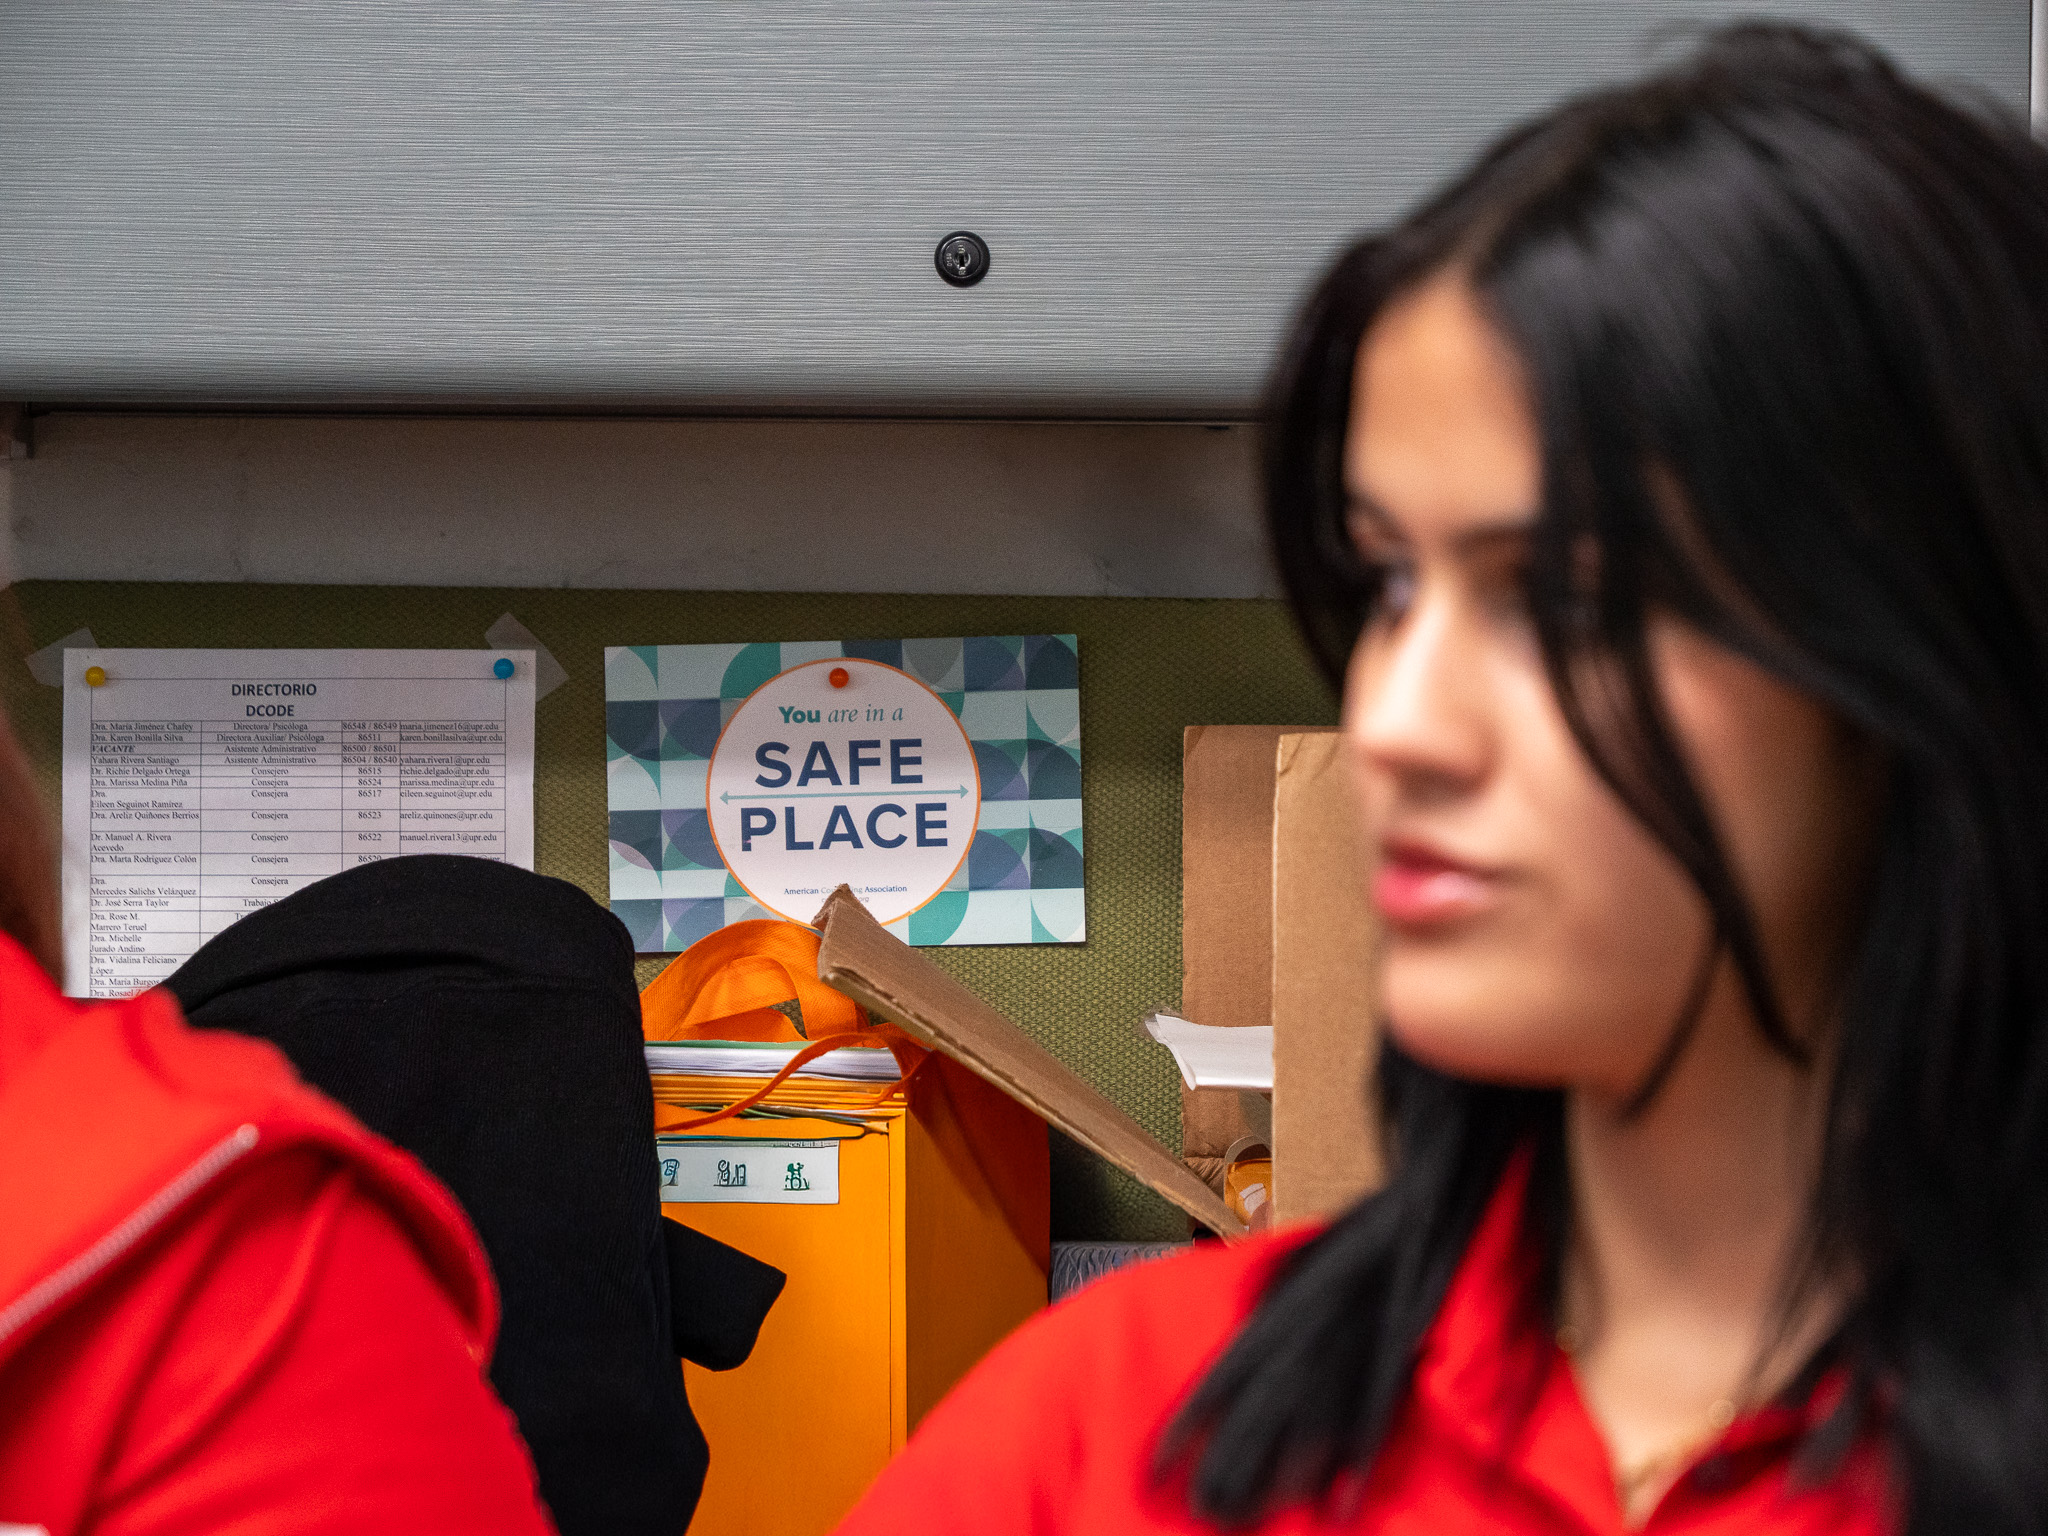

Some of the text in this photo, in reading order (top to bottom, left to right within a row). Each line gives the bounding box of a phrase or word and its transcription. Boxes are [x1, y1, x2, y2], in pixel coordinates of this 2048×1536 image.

[232, 684, 316, 696] DIRECTORIO
[246, 705, 294, 717] DCODE
[778, 704, 904, 724] You are in a
[92, 722, 107, 730] Dra.
[342, 722, 366, 730] 86548
[374, 722, 398, 730] 86549
[92, 732, 184, 742] Dra. Karen Bonilla Silva
[92, 756, 180, 766] Yahara Rivera Santiago
[342, 756, 366, 764] 86504
[374, 756, 398, 764] 86540
[755, 738, 923, 788] SAFE
[132, 768, 163, 776] Delgado
[164, 768, 190, 777] Ortega
[252, 768, 288, 777] Consejero
[358, 767, 382, 775] 86515
[252, 778, 288, 788] Consejera
[252, 790, 288, 799] Consejera
[358, 790, 382, 798] 86517
[116, 800, 150, 810] Seguinot
[252, 812, 288, 821] Consejera
[358, 812, 382, 820] 86523
[740, 802, 948, 852] PLACE
[92, 833, 172, 841] Dr. Manuel A. Rivera
[252, 833, 288, 842] Consejero
[92, 855, 107, 863] Dra.
[110, 855, 132, 863] Marta
[252, 855, 288, 864] Consejera
[91, 877, 107, 885] Dra.
[252, 877, 288, 886] Consejera
[864, 885, 908, 894] Association
[90, 899, 170, 908] Dr. José Serra Taylor
[90, 934, 142, 942] Dra. Michelle
[90, 978, 106, 986] Dra.
